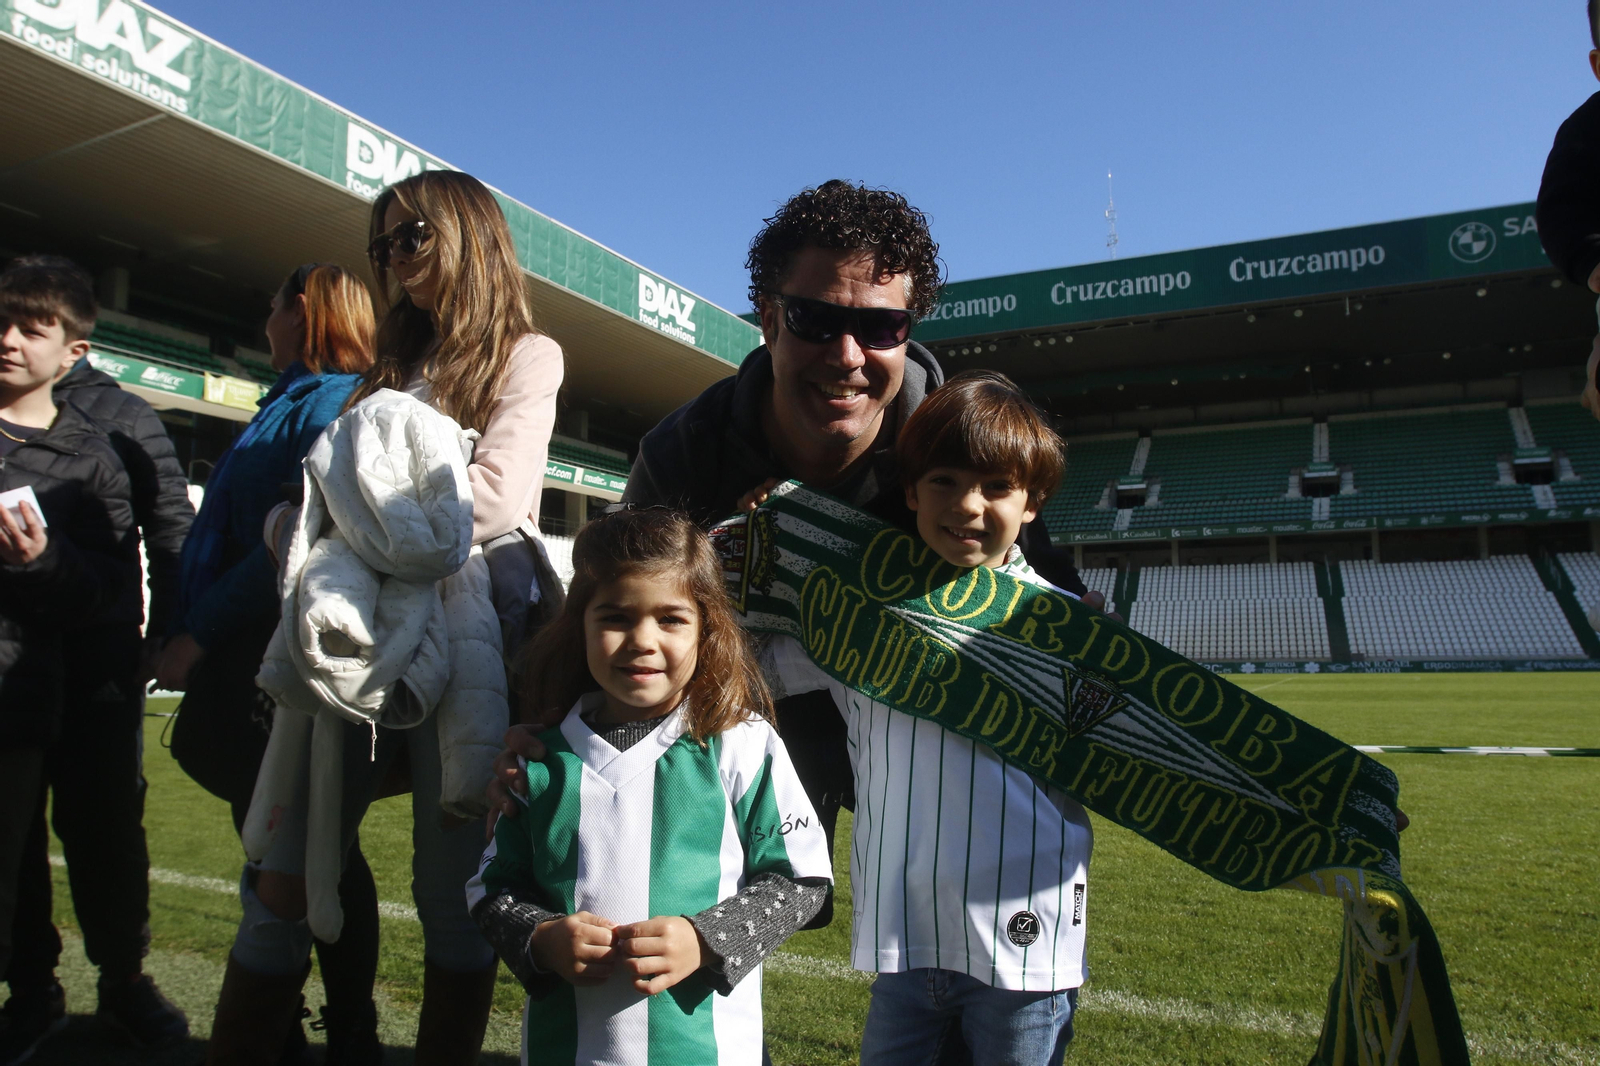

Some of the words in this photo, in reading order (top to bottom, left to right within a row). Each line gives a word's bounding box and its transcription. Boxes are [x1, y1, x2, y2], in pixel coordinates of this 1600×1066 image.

[11, 13, 75, 61] food
[81, 52, 189, 113] solutions
[346, 121, 443, 187] DIA
[1051, 271, 1191, 305] Cruzcampo
[1229, 245, 1385, 283] Cruzcampo
[639, 273, 696, 332] DIAZ
[639, 309, 659, 328] food
[660, 322, 696, 345] solutions
[800, 565, 960, 717] CLUB
[956, 672, 1069, 778] DE
[861, 527, 1362, 830] CORDOBA
[1374, 660, 1413, 668] RAFAEL
[1074, 889, 1082, 920] MATCH
